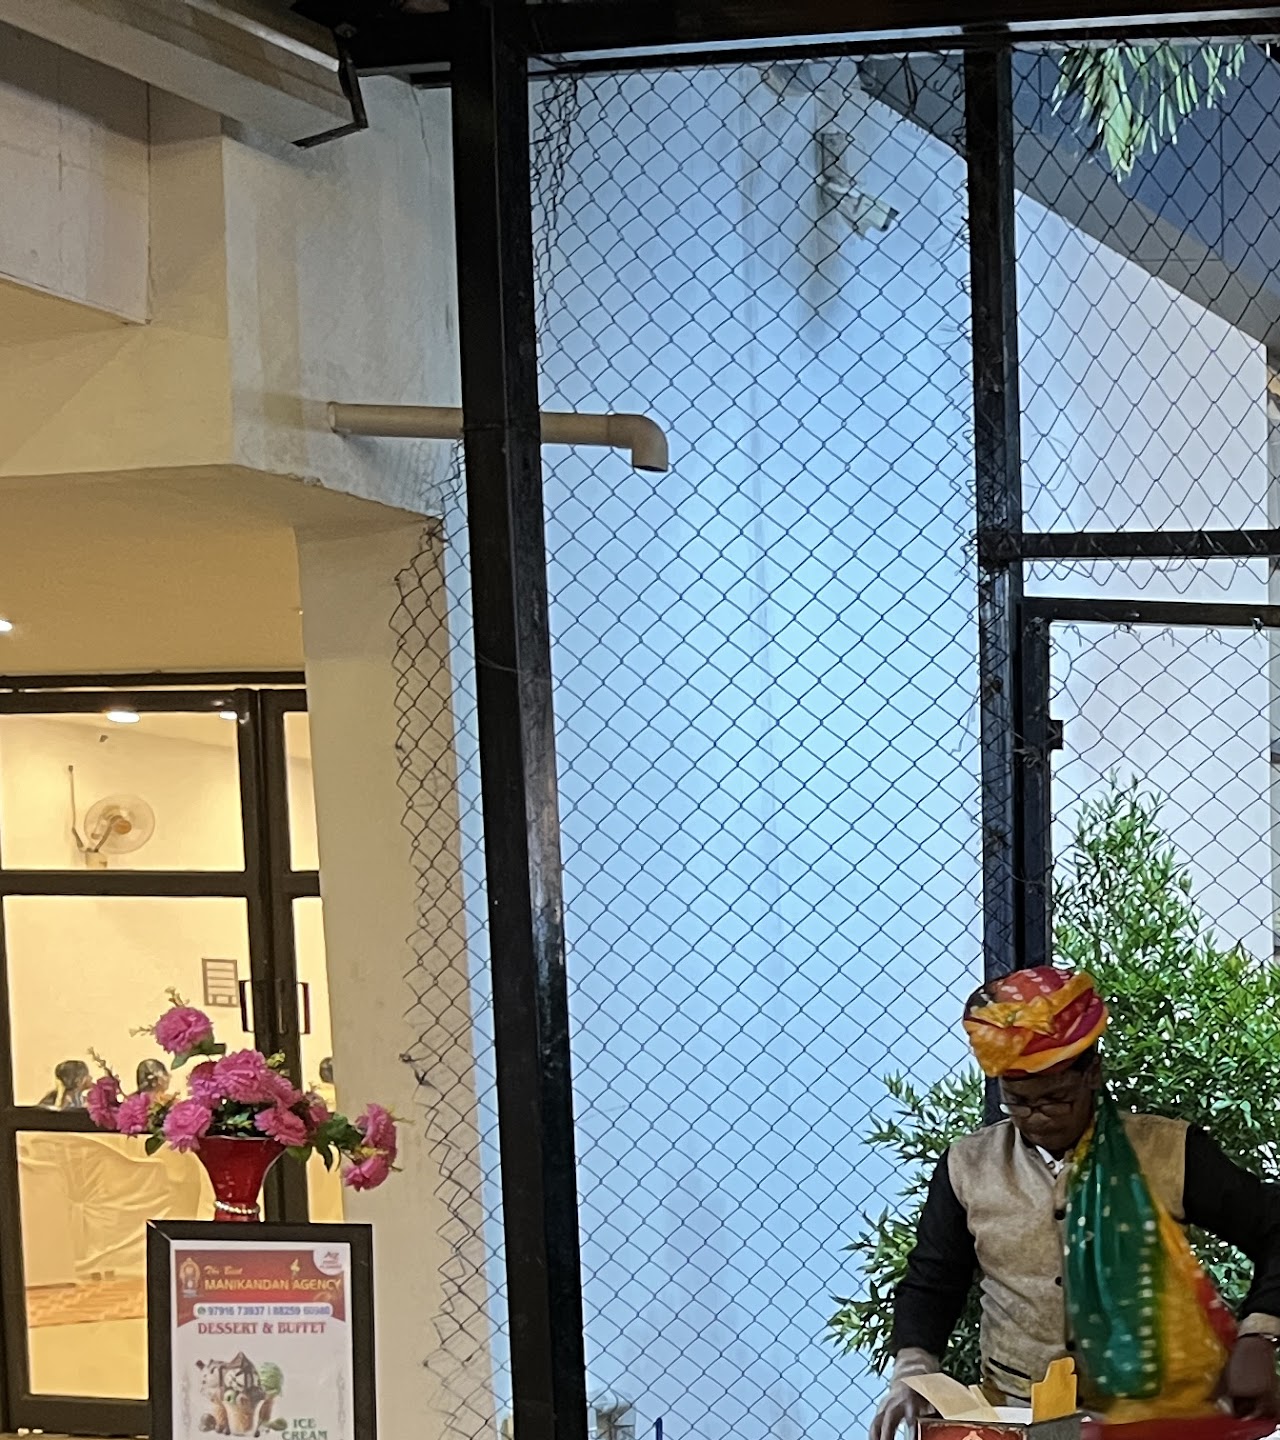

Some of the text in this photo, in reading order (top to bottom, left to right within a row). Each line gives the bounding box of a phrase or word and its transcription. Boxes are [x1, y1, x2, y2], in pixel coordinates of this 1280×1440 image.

[204, 1279, 341, 1291] MANIKANDAN AGENCY
[198, 1322, 327, 1335] DESSERT & BUFFET
[293, 1418, 317, 1429] ICE
